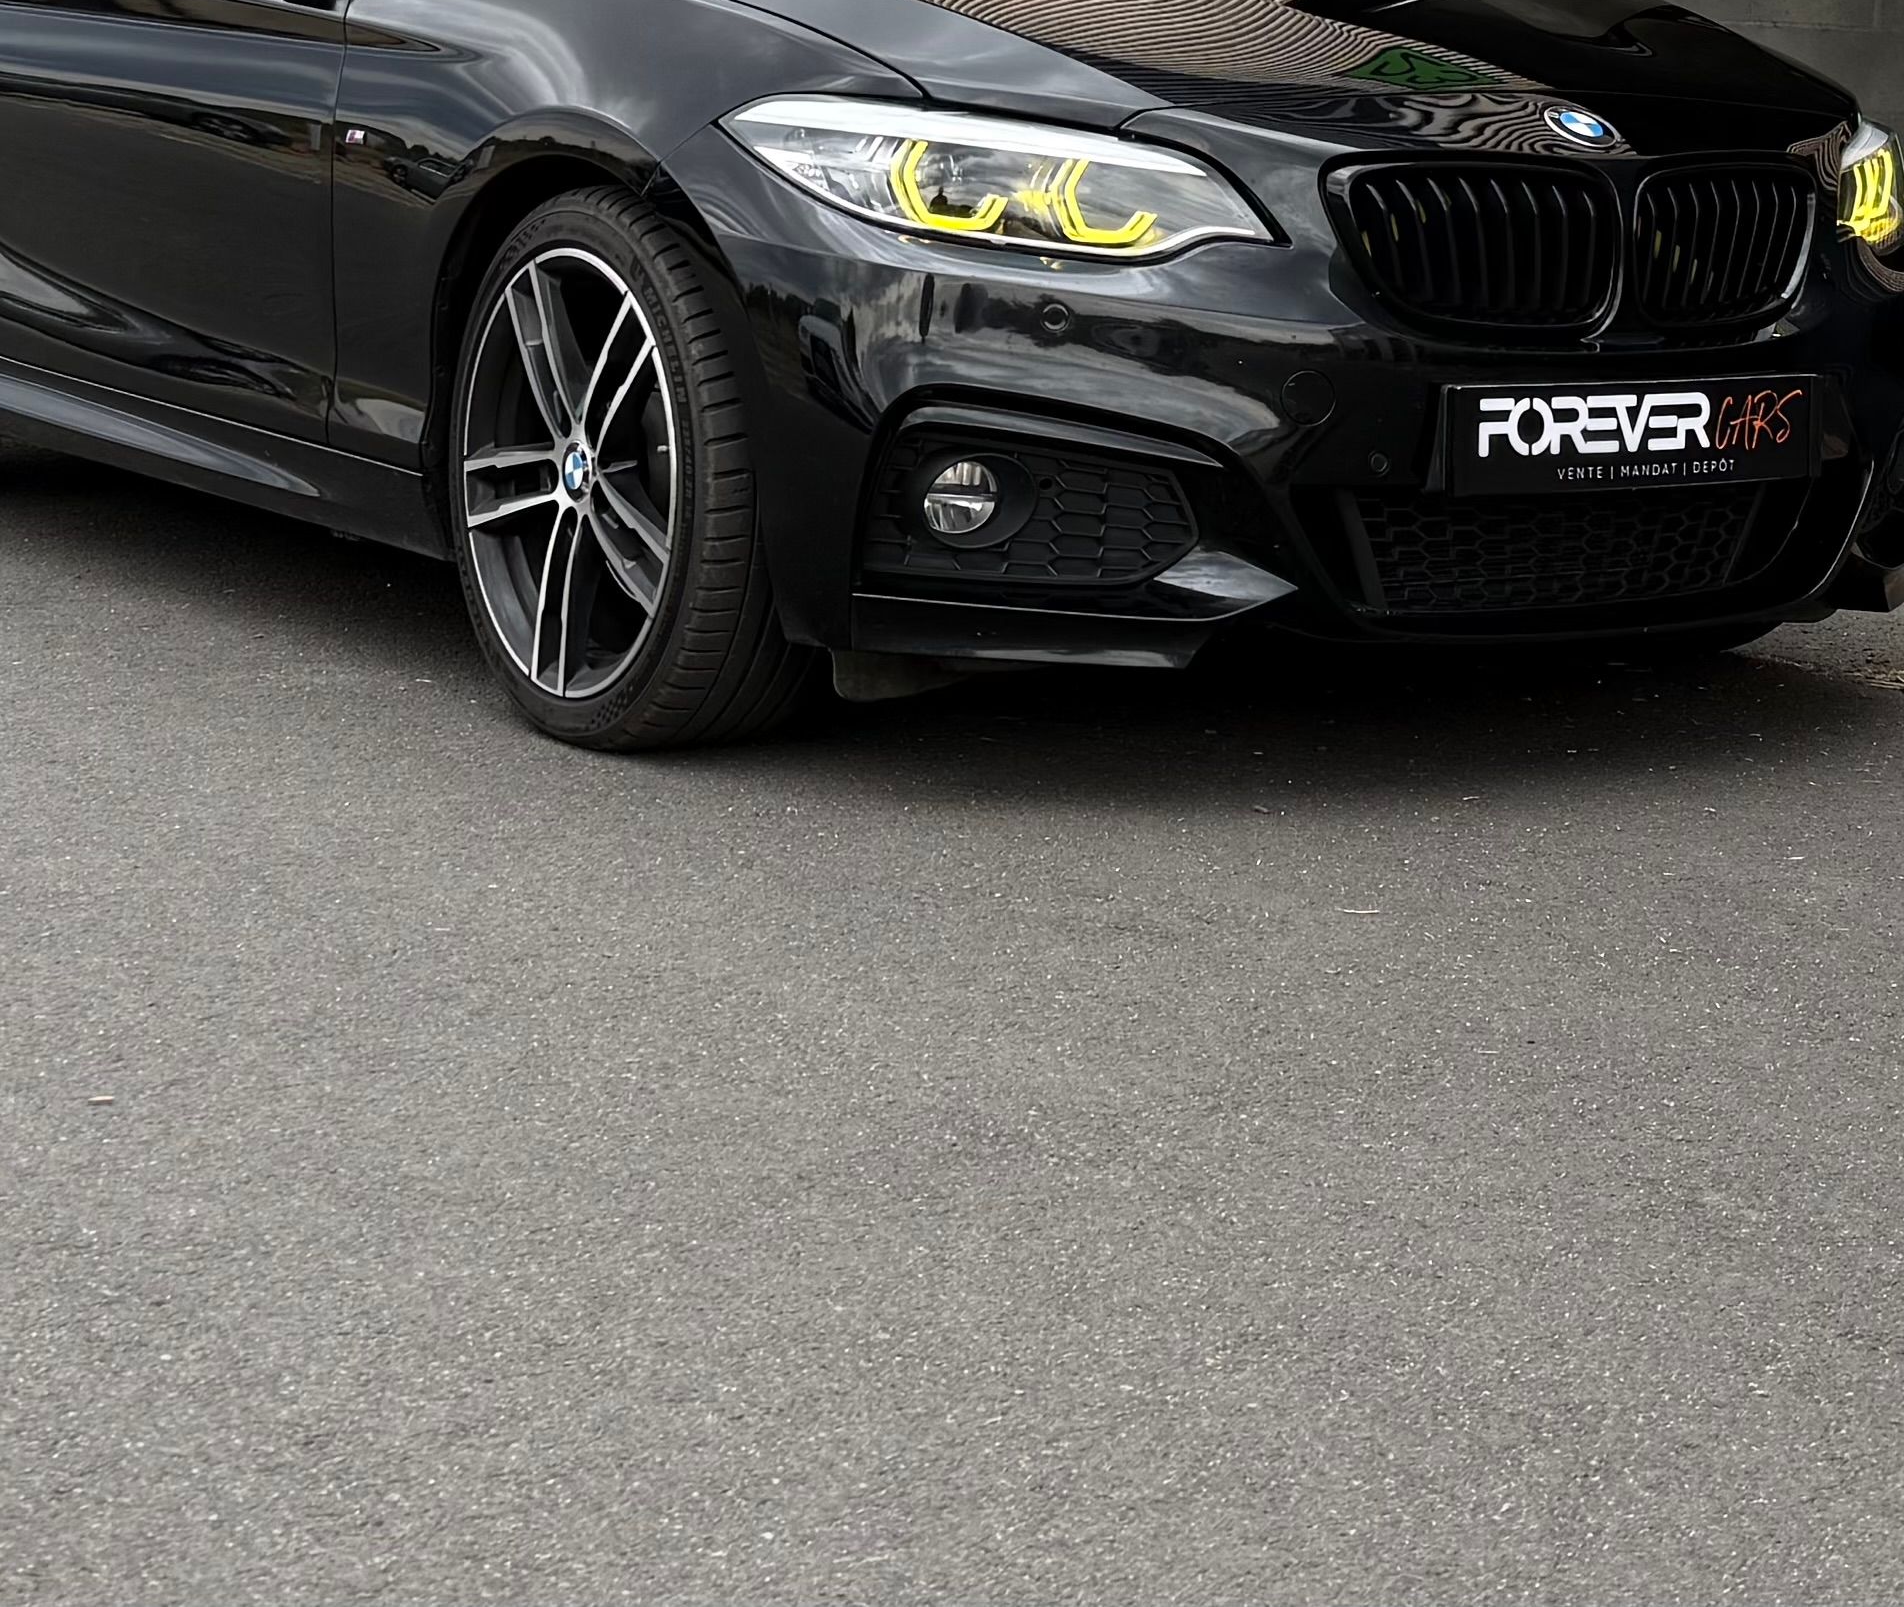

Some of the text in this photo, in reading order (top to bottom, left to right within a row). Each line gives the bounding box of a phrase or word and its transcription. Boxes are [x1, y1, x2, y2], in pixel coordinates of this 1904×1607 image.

[1478, 389, 1802, 457] FOREVER CARS
[1557, 458, 1735, 480] VENTE MANDAT DEPÔT
